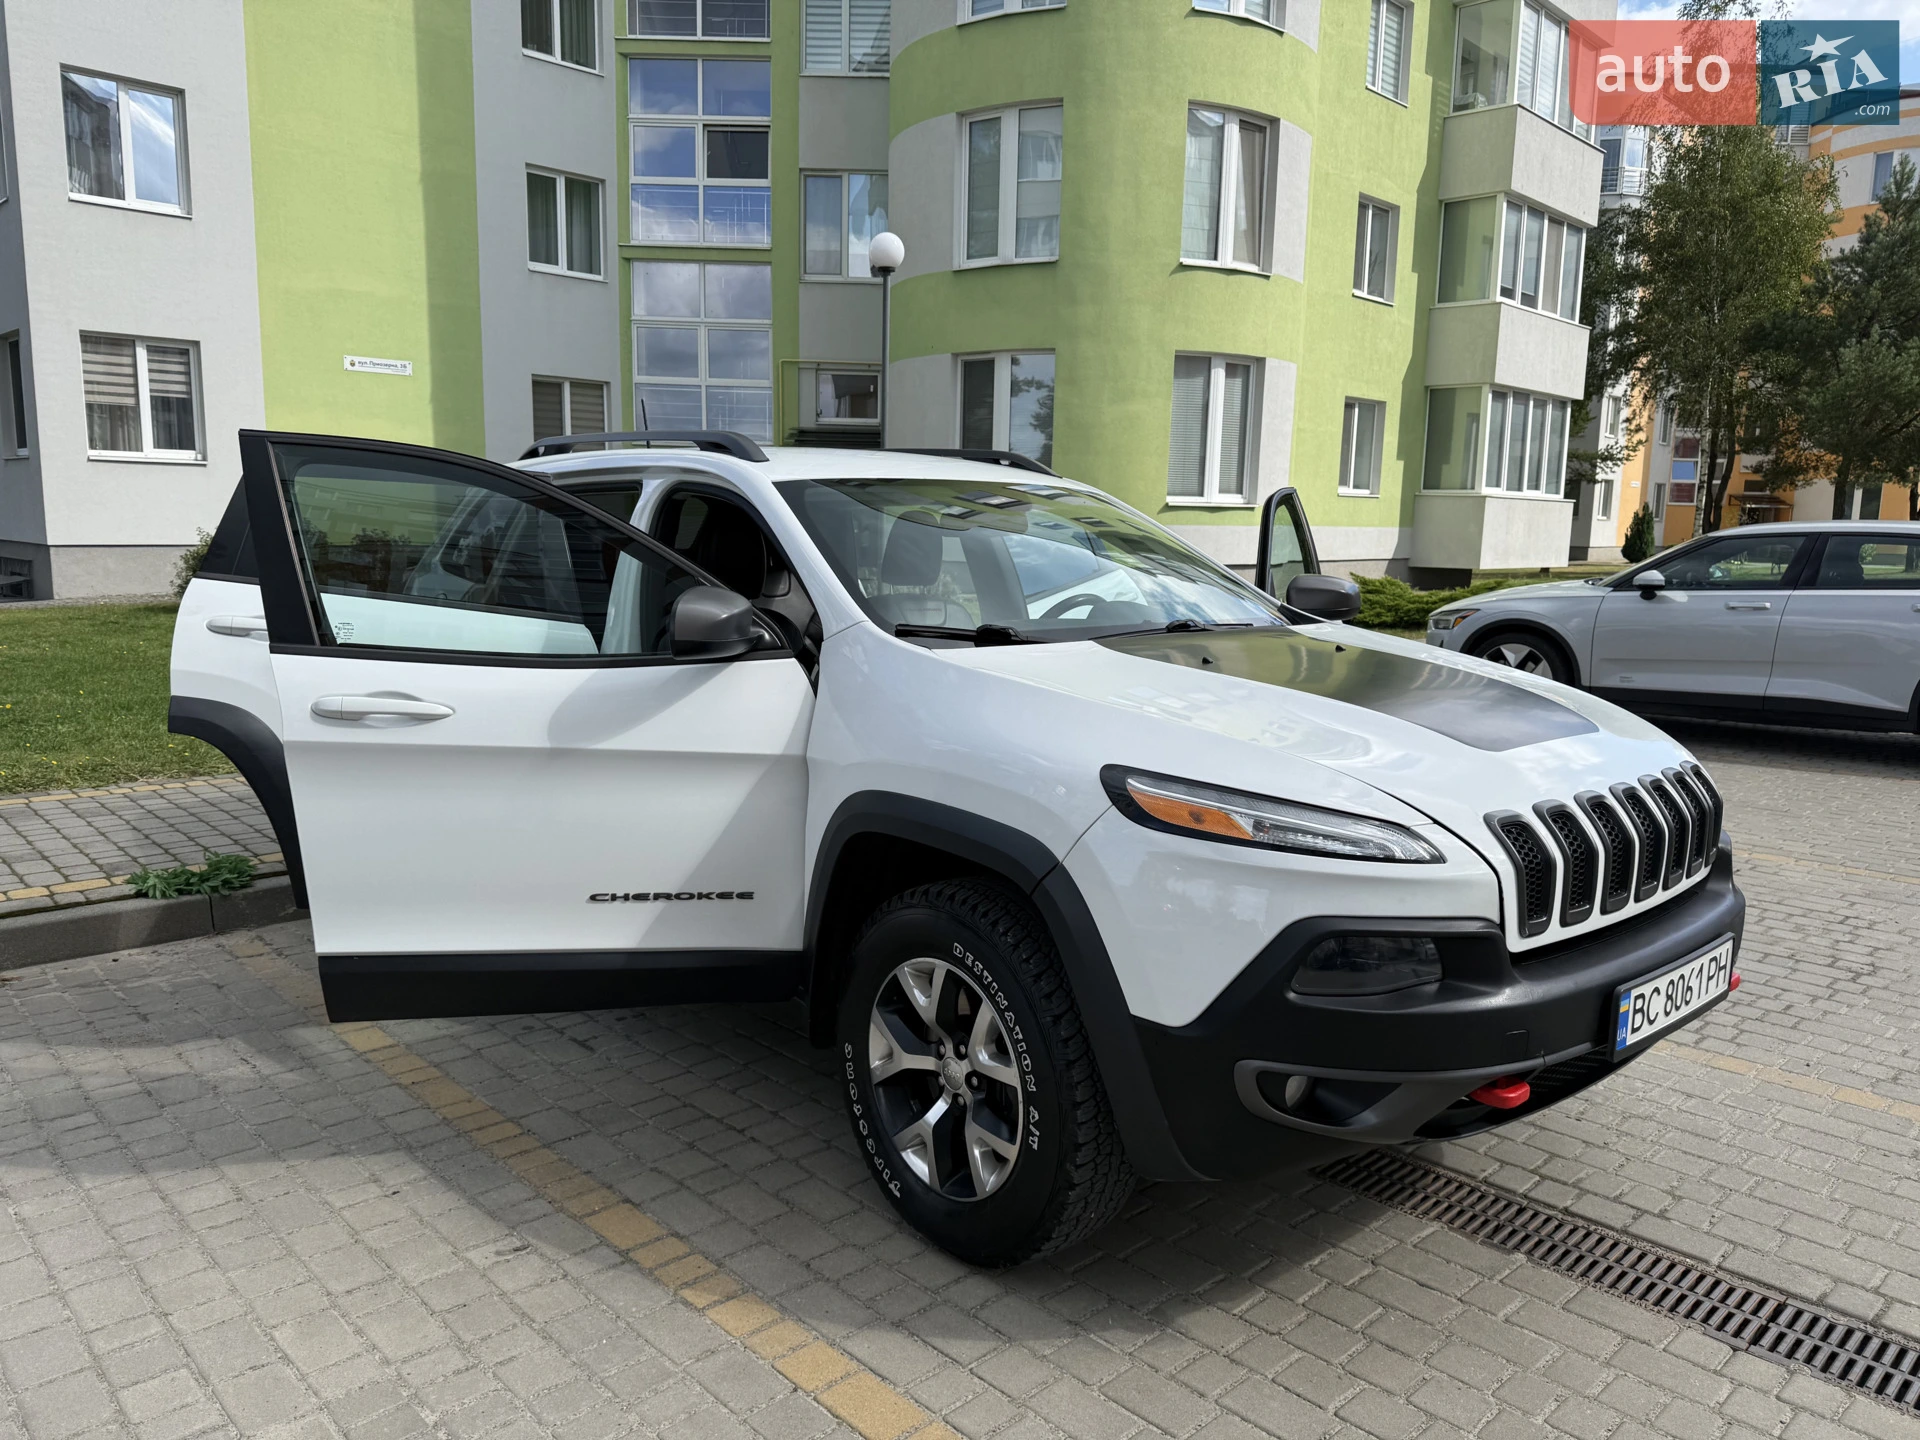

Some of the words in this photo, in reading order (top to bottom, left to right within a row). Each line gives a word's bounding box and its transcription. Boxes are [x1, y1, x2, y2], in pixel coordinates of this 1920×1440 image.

[589, 891, 755, 902] CHEROKEE
[1630, 986, 1661, 1035] BC
[1664, 962, 1704, 1018] 8061
[1705, 947, 1730, 996] PH
[952, 942, 1037, 1092] DESTINATION
[1028, 1105, 1041, 1151] A/T
[1616, 1026, 1627, 1041] UA
